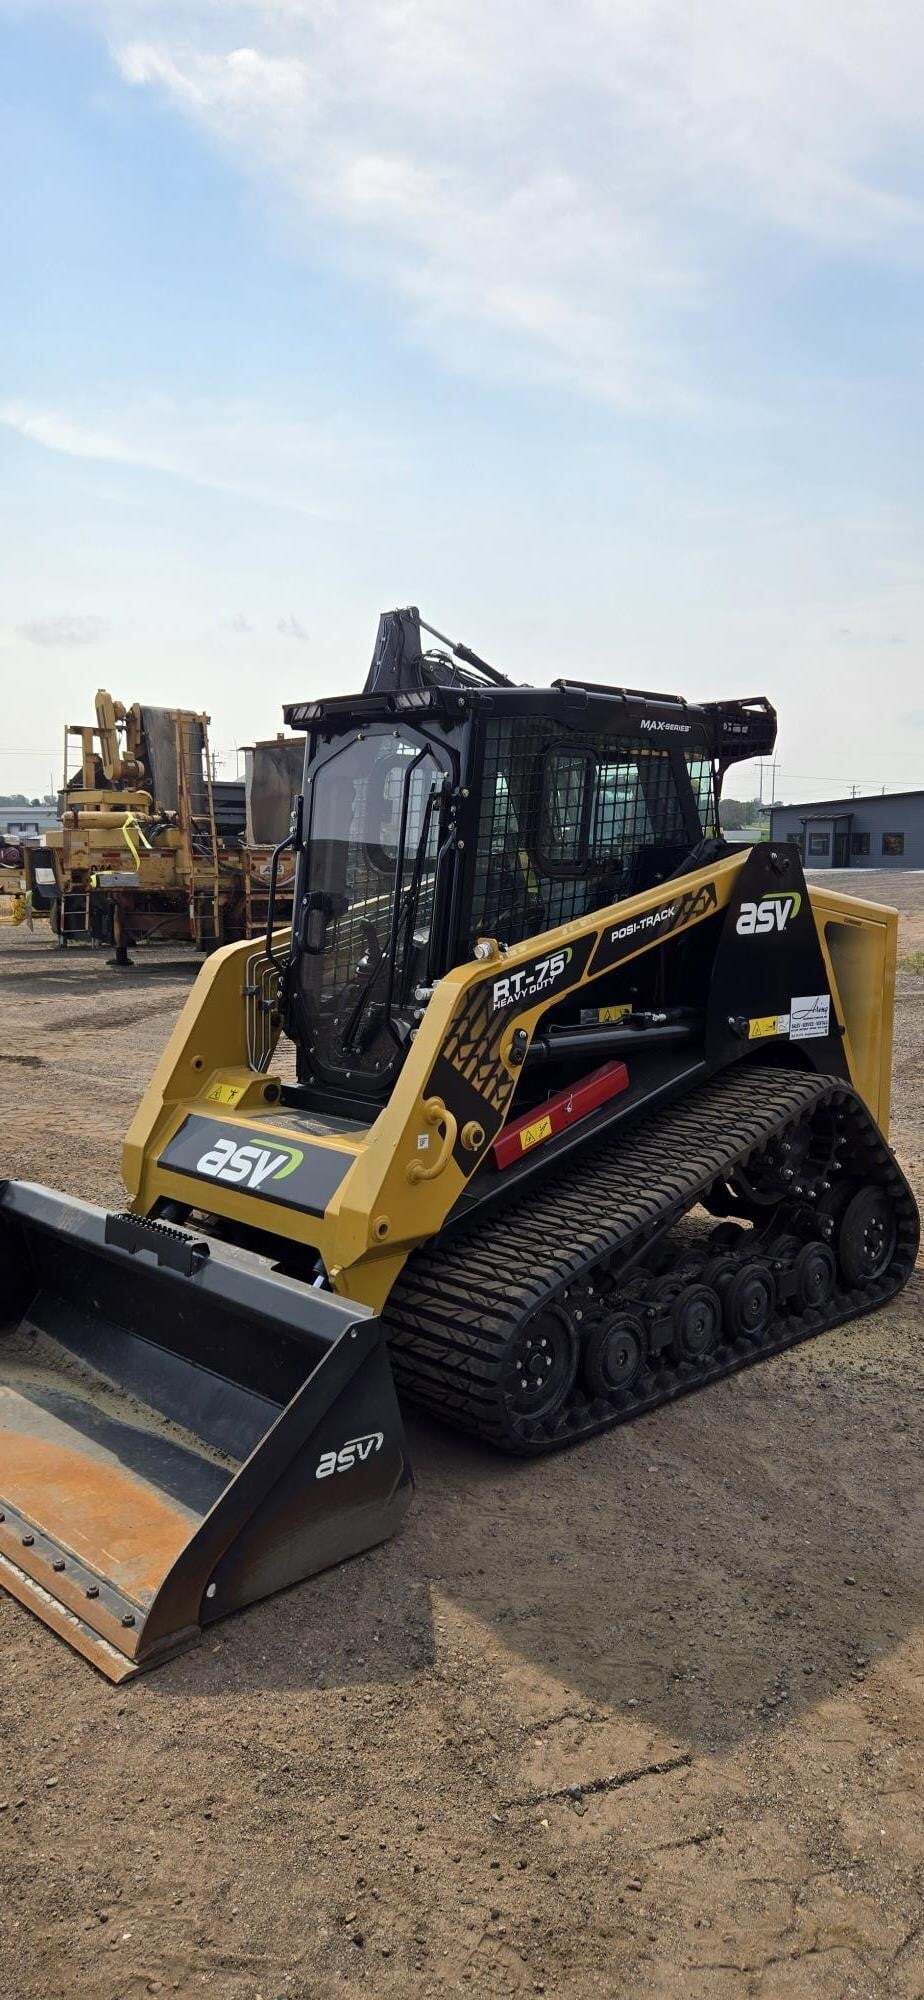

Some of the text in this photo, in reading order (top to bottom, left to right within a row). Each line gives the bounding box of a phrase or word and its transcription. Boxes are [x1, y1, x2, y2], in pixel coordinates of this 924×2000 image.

[611, 906, 675, 943] POSI-TRACK
[493, 953, 565, 1001] RT-75
[493, 976, 555, 1011] HEAVY DUTY
